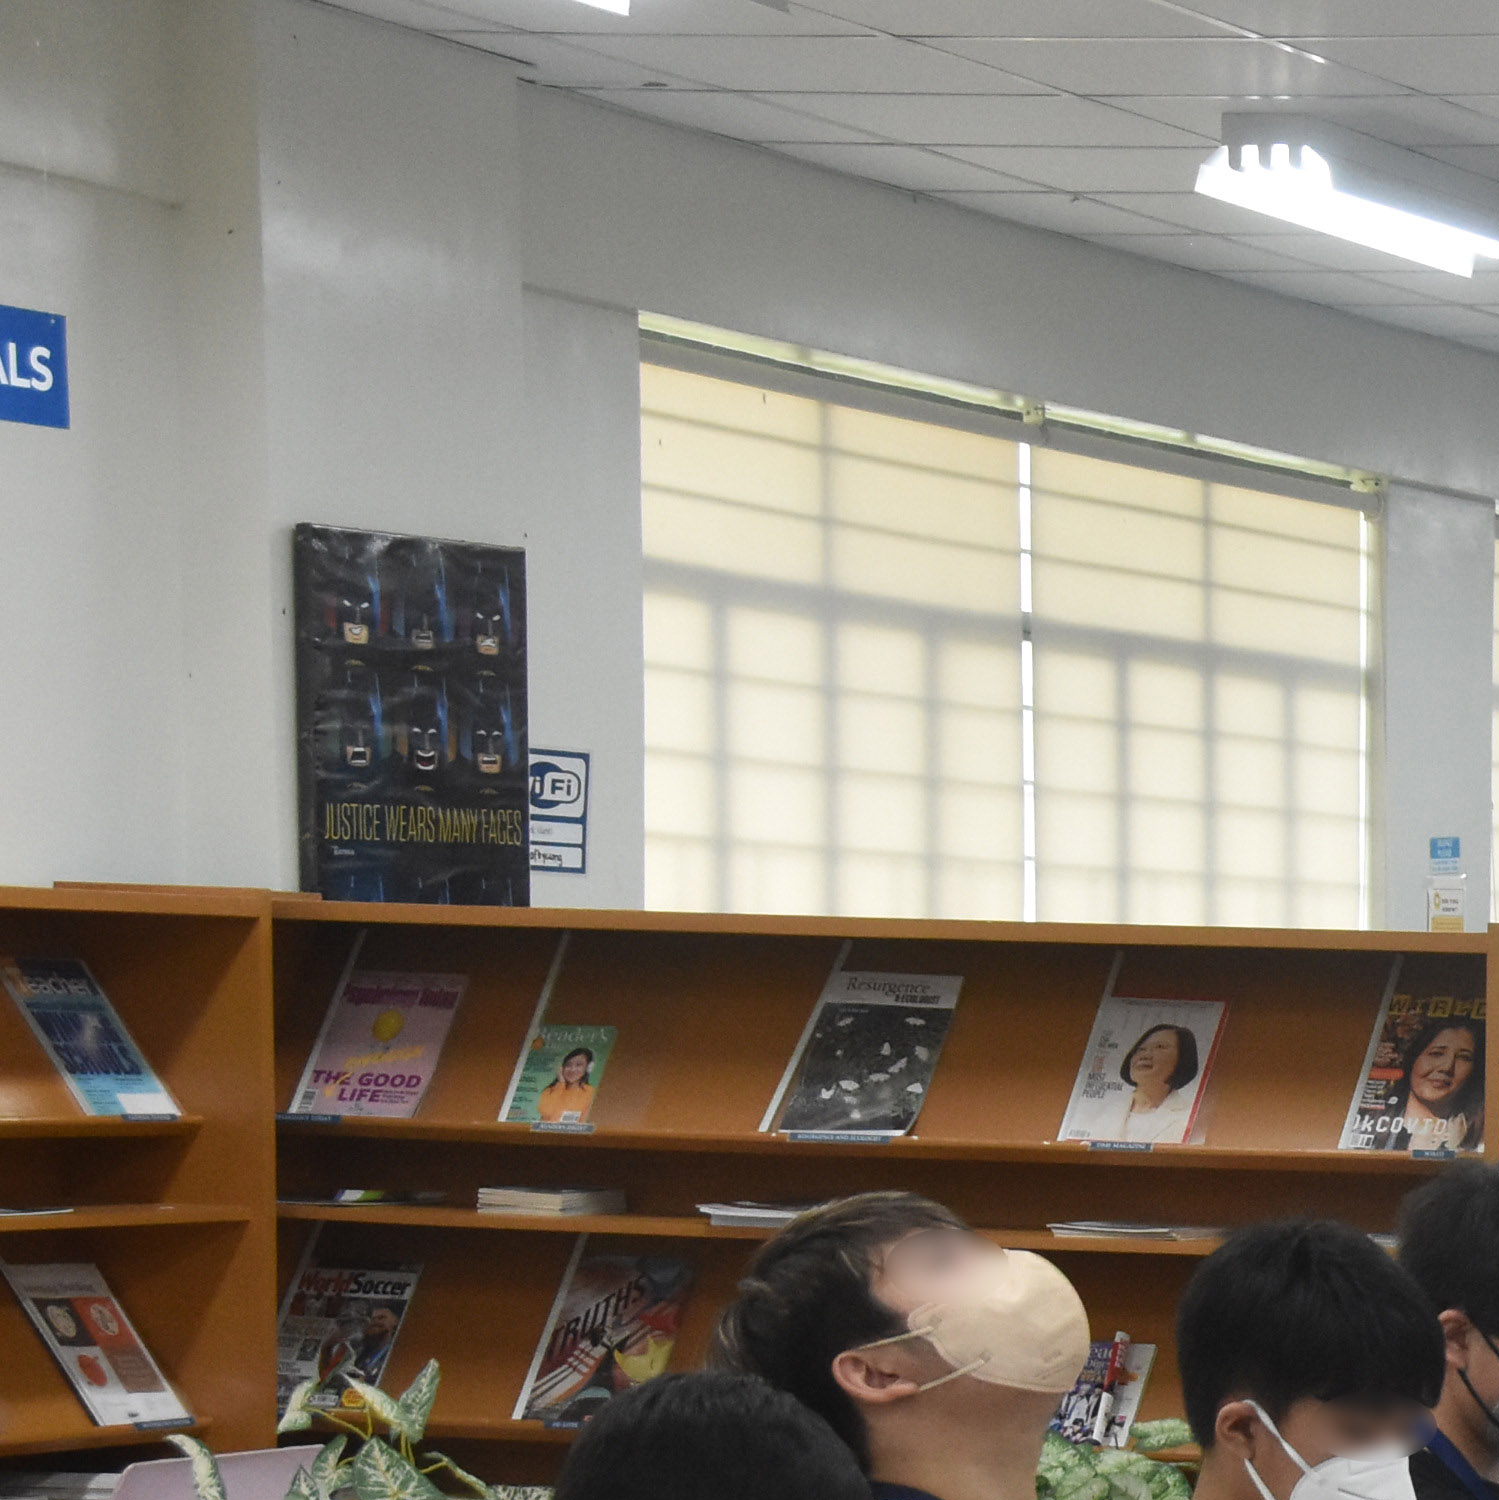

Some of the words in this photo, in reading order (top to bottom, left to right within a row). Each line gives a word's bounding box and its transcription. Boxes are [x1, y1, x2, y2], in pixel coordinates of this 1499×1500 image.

[324, 802, 380, 841] JUSTICE
[384, 804, 435, 842] WEARS
[438, 807, 478, 843] MANY
[481, 808, 522, 845] FACES
[846, 976, 931, 997] Resurgence
[313, 1070, 353, 1084] THE
[358, 1072, 421, 1088] GOOD
[337, 1088, 382, 1103] LIFE
